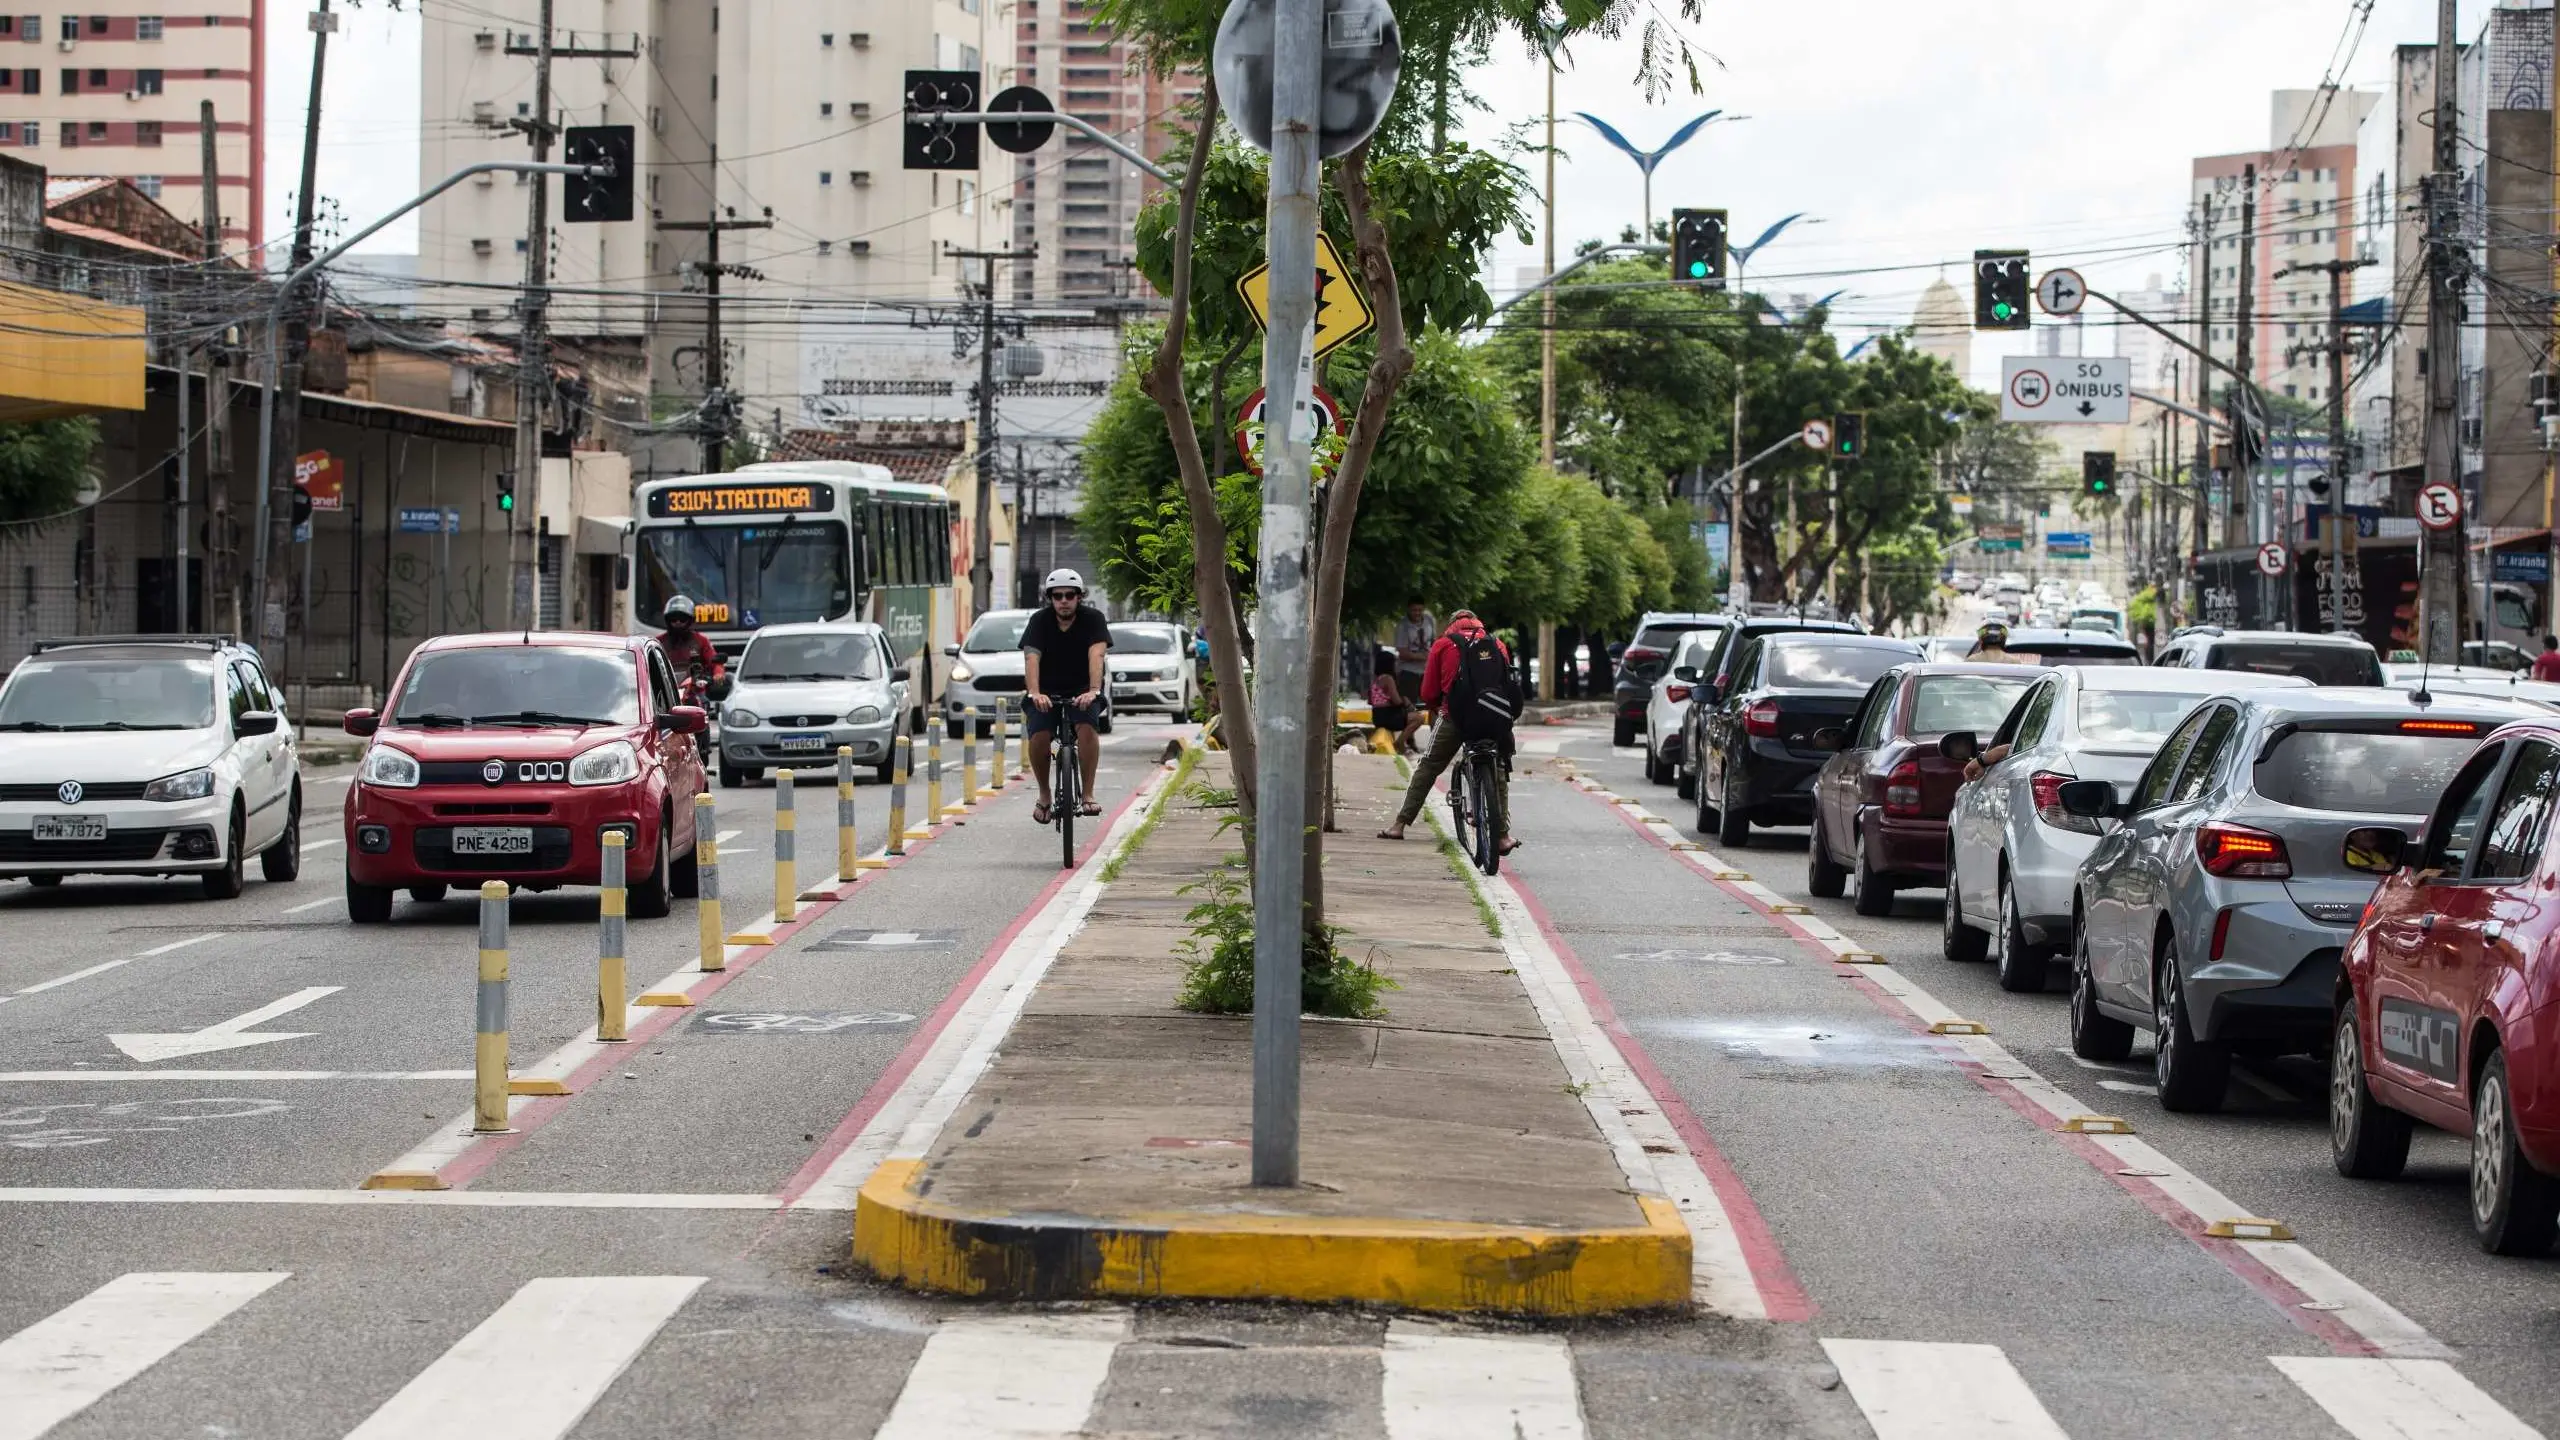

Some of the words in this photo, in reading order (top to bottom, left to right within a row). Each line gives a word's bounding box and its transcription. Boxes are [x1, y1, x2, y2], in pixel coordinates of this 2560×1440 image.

[2077, 360, 2102, 378] SÓ
[2055, 379, 2123, 398] ÔNIBUS
[669, 491, 712, 511] 33104
[714, 487, 810, 510] ITAITINGA
